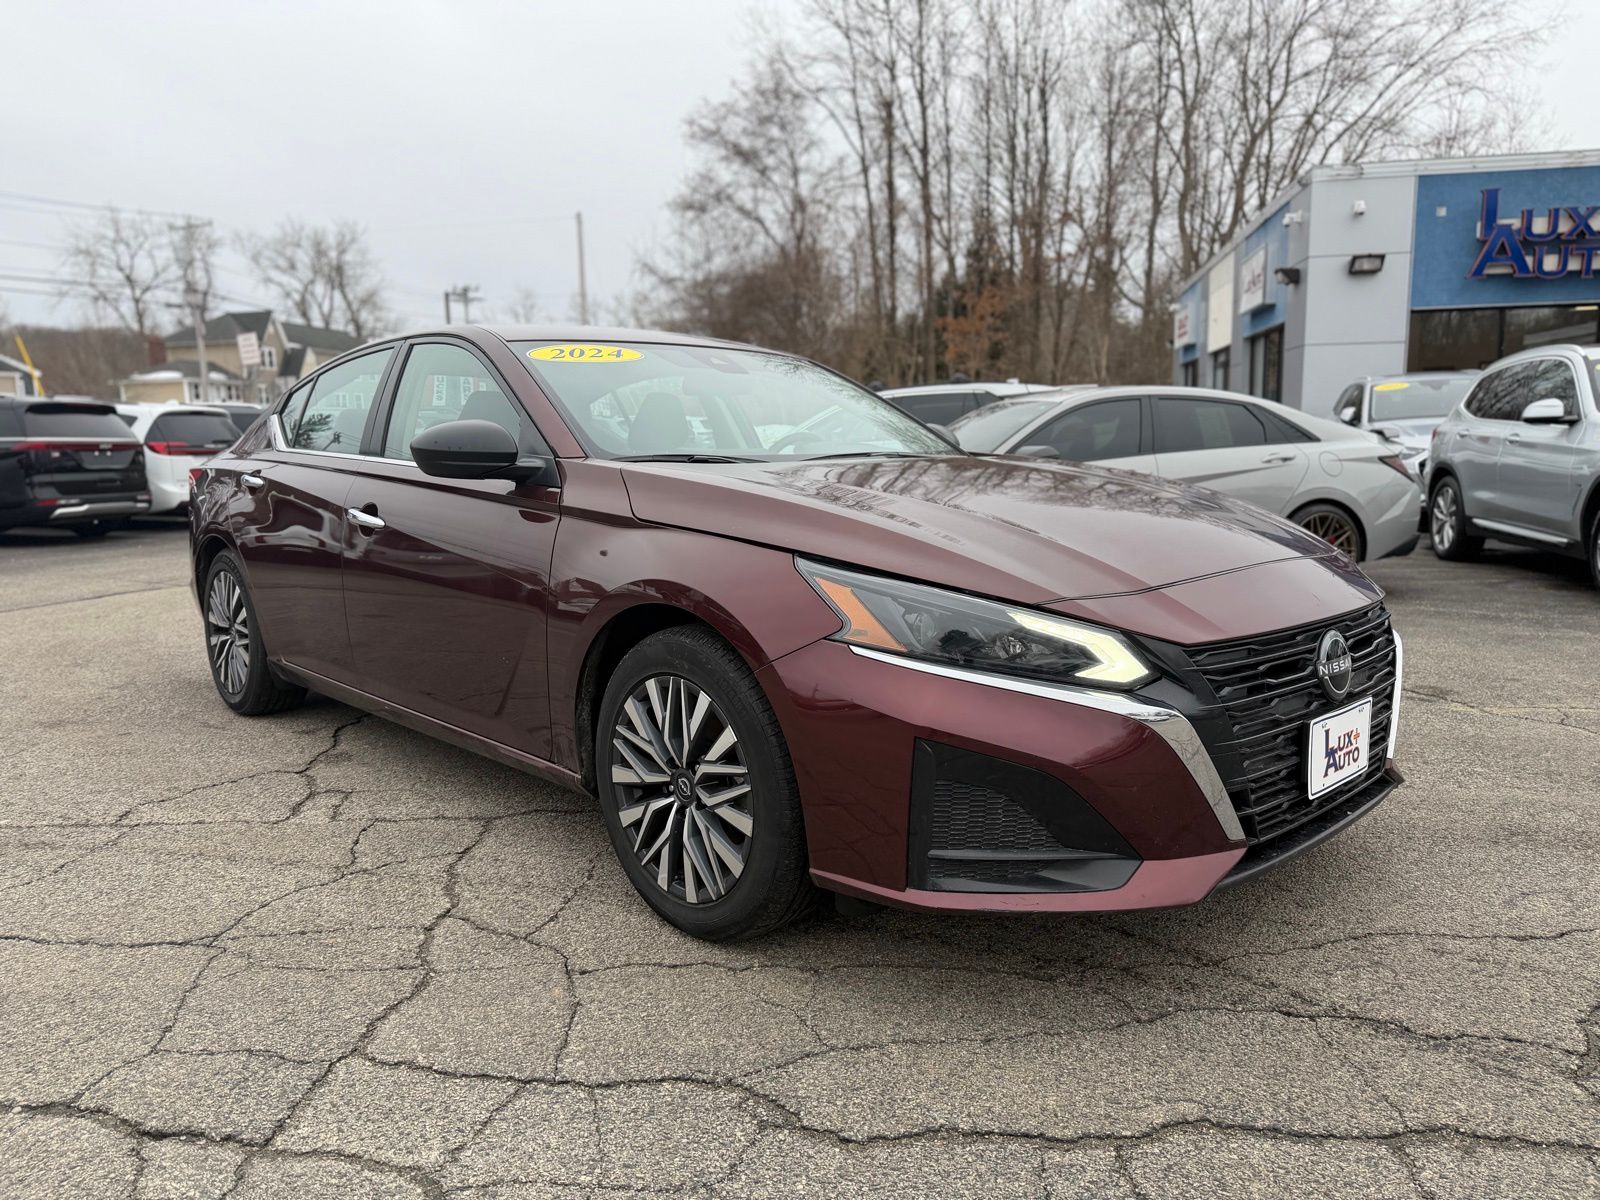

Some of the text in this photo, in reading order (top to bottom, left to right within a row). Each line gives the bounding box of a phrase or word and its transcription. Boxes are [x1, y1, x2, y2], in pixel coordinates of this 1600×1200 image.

[550, 348, 623, 359] 2024
[1319, 657, 1351, 676] NISSA
[1323, 746, 1360, 778] AUTO
